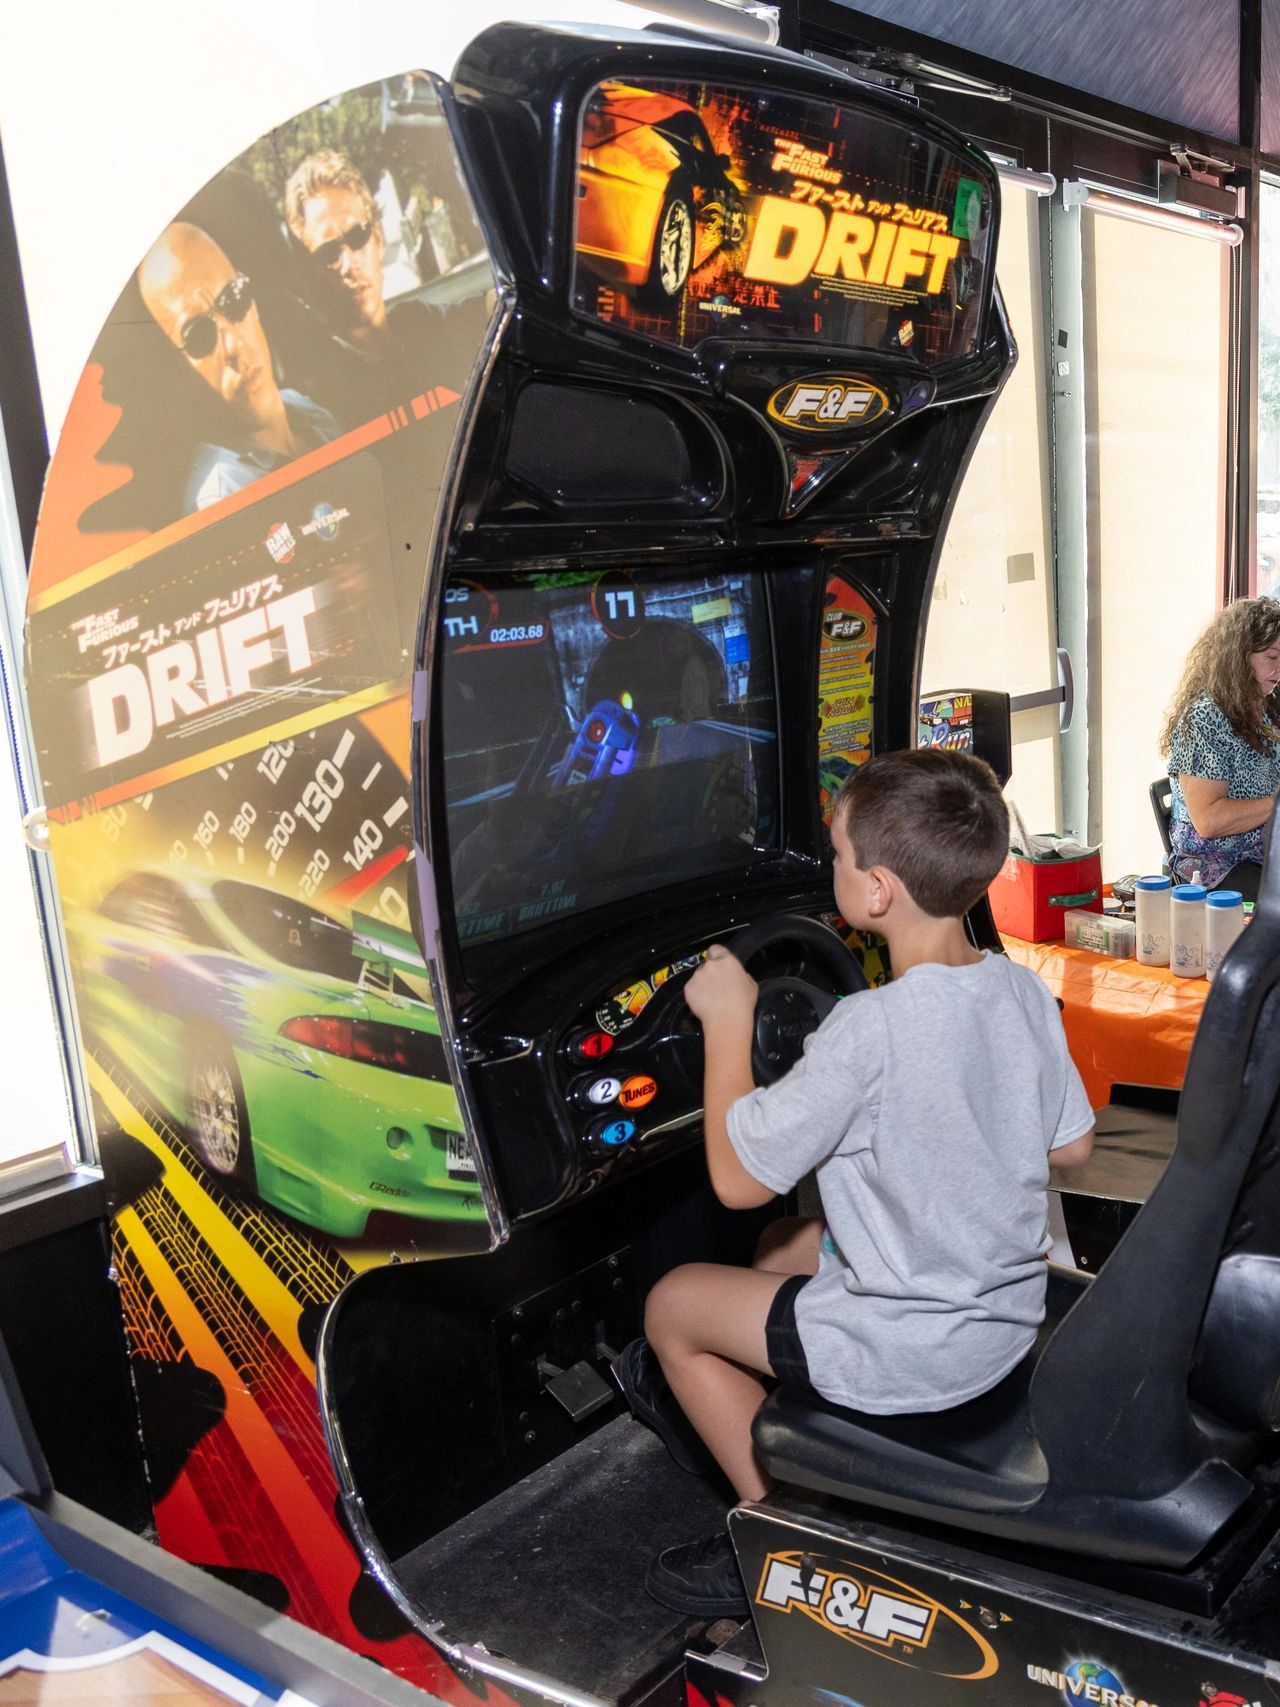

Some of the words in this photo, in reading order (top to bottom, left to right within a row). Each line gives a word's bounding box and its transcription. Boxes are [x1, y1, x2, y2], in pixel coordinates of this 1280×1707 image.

[772, 153, 843, 184] FURIOUS
[789, 144, 829, 165] FAST
[744, 195, 960, 296] DRIFT
[699, 301, 742, 316] UNIVERSAL
[784, 388, 874, 419] F&F
[301, 507, 351, 536] UNIVERSAL
[266, 522, 292, 553] RAW
[605, 590, 637, 619] 17
[827, 612, 843, 622] CLUB
[78, 616, 140, 654] FURIOUS
[83, 608, 120, 634] FAST
[489, 624, 545, 644] 02:03.68
[831, 621, 862, 637] F&F
[87, 586, 316, 768] DRIFT
[295, 759, 345, 833] 130
[193, 810, 220, 851] 160
[229, 801, 257, 844] 180
[264, 810, 297, 863] 200
[343, 819, 383, 871] 140
[600, 1081, 613, 1101] 2
[621, 1082, 655, 1103] TUNES
[614, 1122, 627, 1142] 3
[761, 1560, 931, 1640] F&F
[1027, 1664, 1160, 1707] UNIVERS
